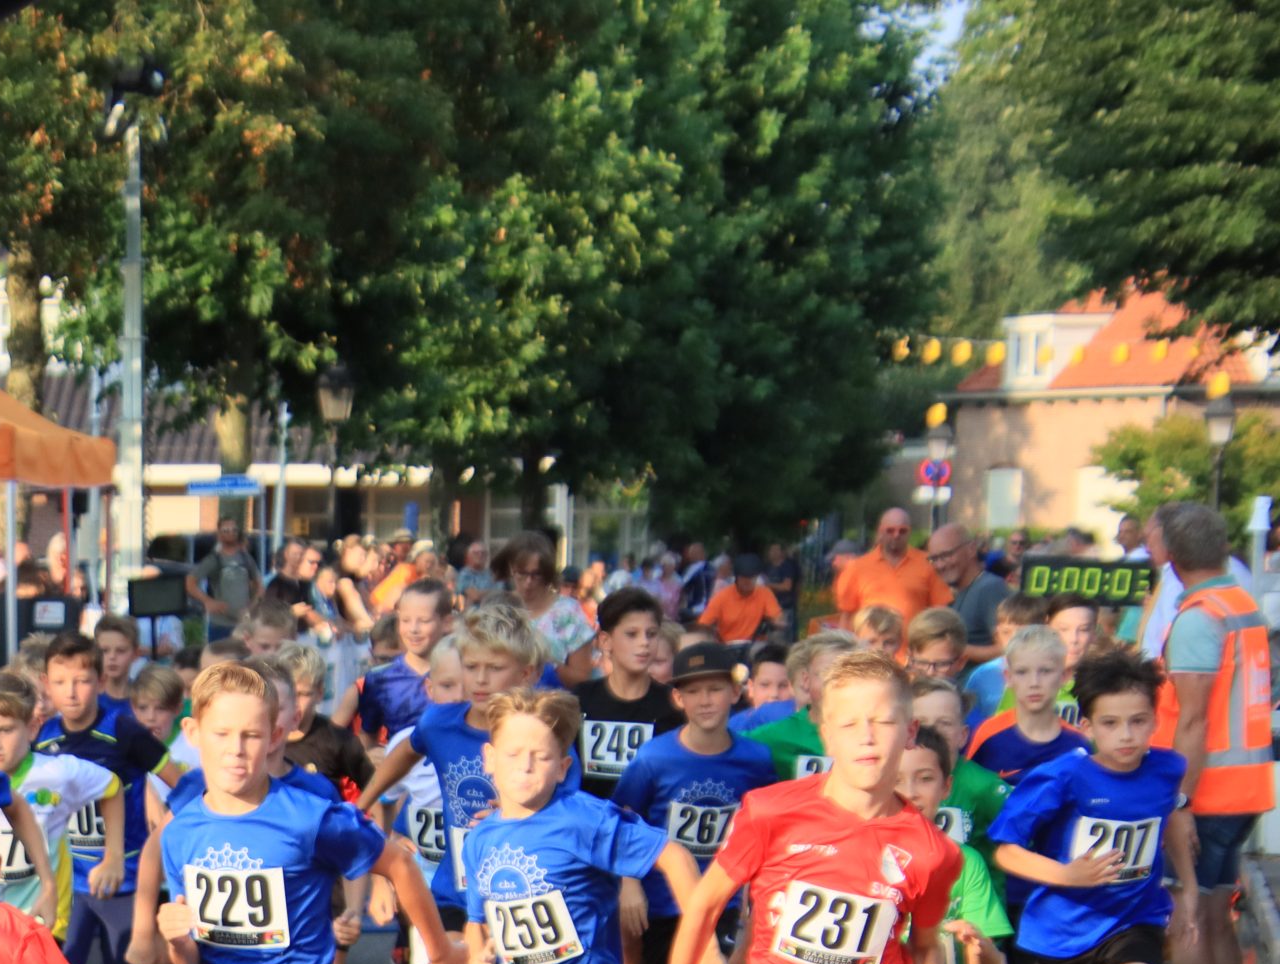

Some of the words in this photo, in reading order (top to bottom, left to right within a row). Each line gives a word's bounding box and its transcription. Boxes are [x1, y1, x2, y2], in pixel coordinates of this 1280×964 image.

[590, 723, 645, 762] 249
[676, 806, 736, 845] 267
[1088, 821, 1154, 870] 207
[196, 872, 273, 928] 229
[791, 888, 881, 953] 231
[495, 900, 564, 951] 259
